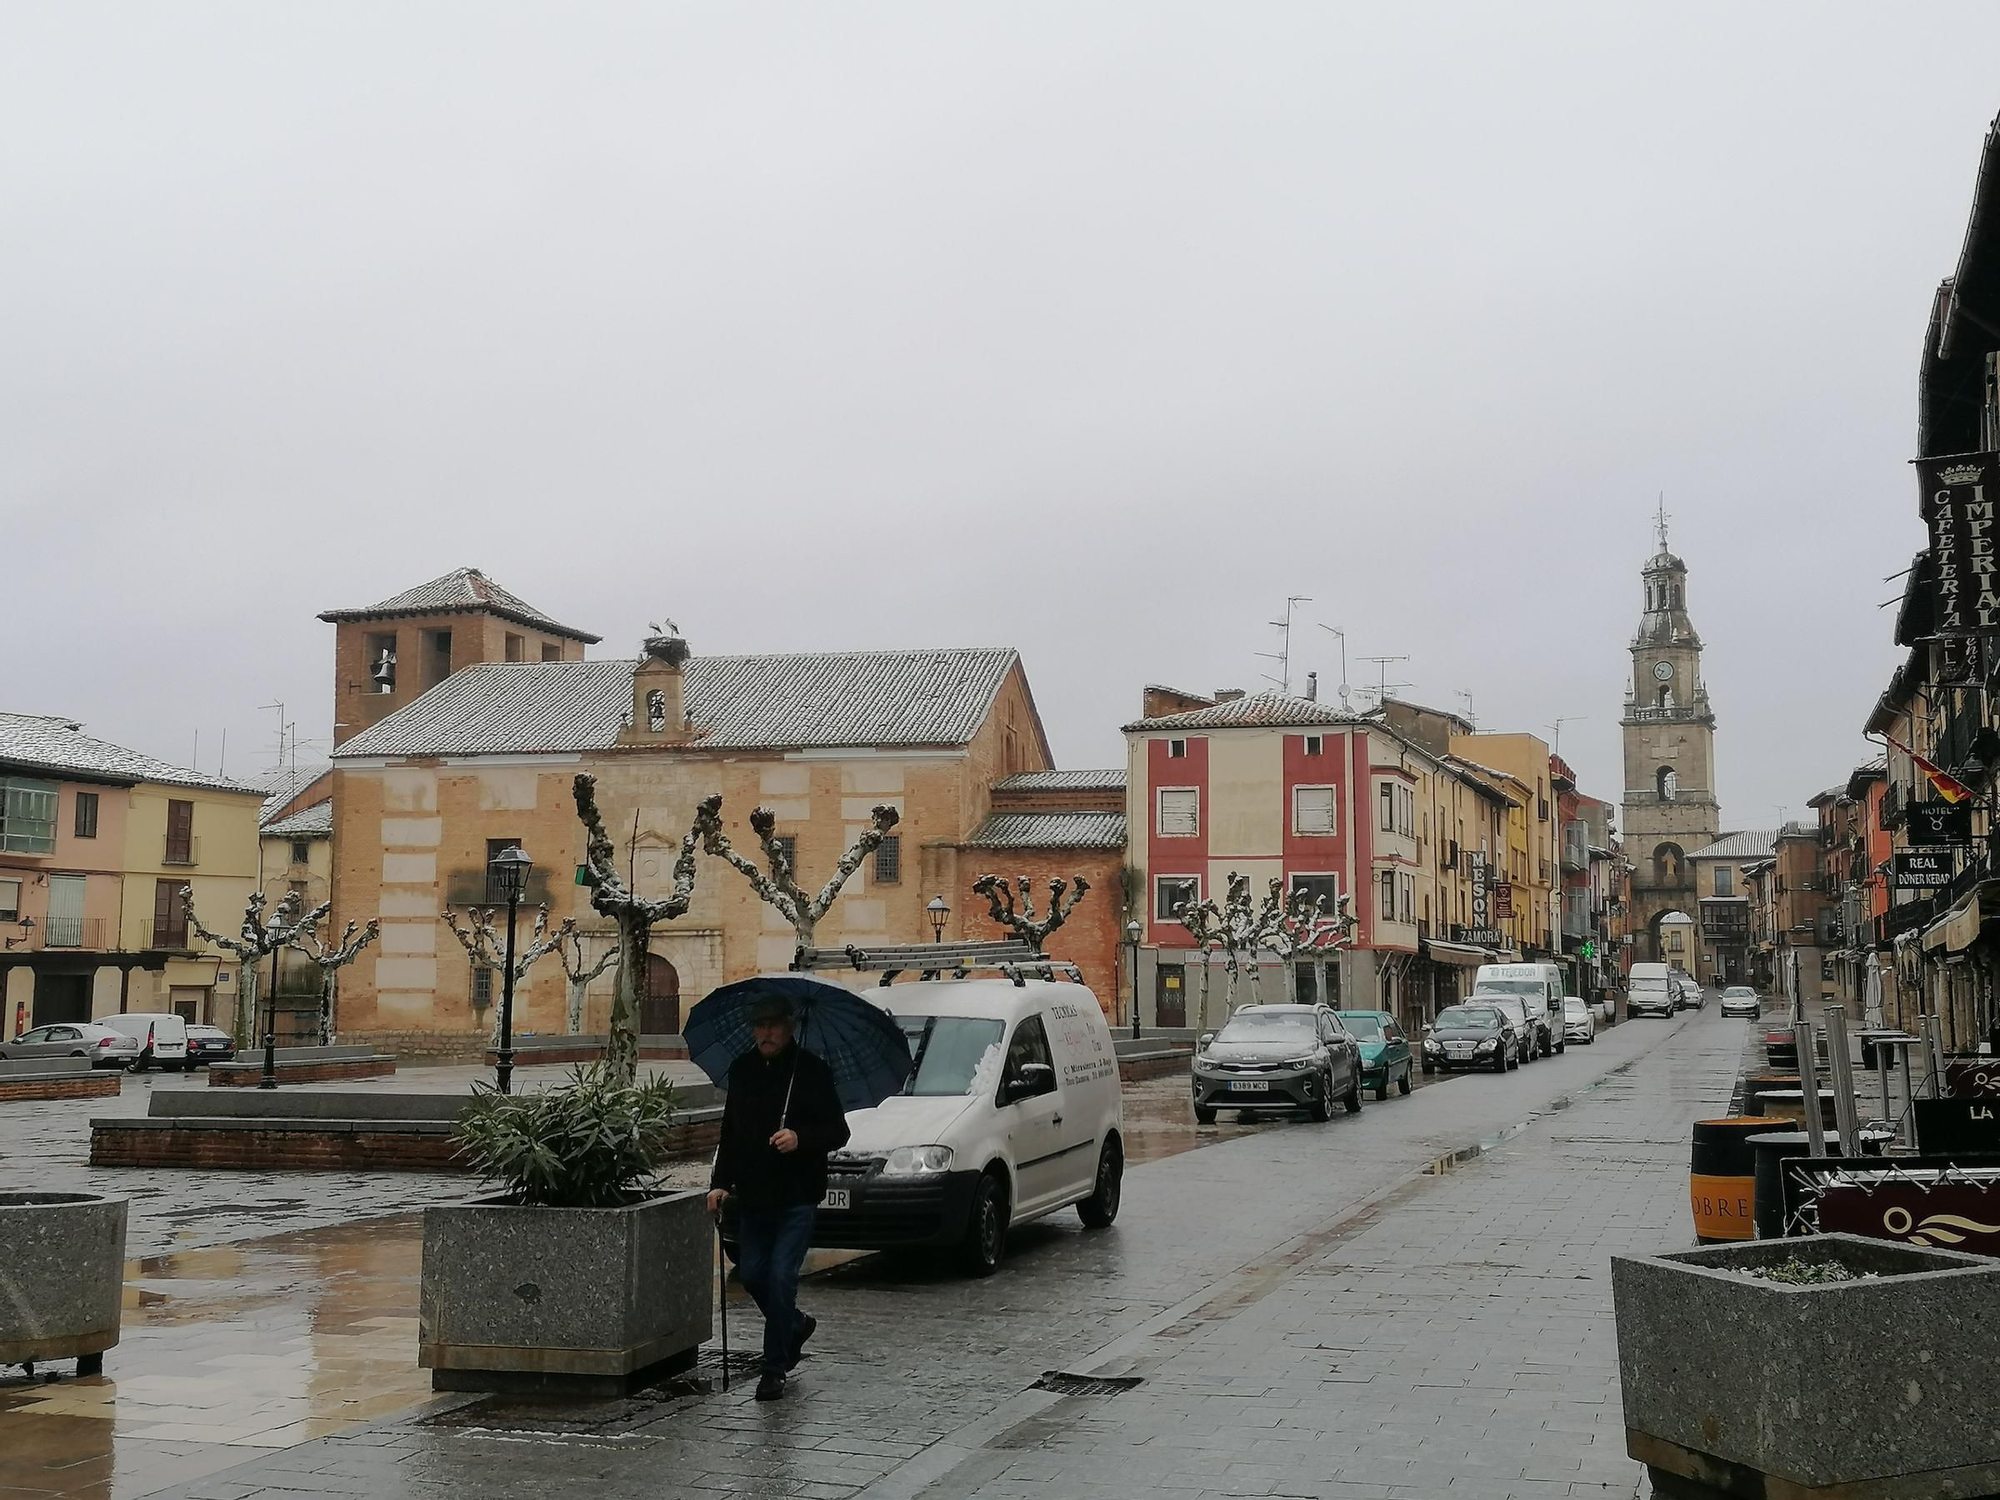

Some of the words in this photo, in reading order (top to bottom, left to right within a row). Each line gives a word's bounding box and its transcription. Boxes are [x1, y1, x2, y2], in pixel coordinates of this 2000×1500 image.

[1934, 489, 1961, 628] CAFETERÍA
[1964, 485, 1998, 626] IMPERIAL
[1909, 858, 1938, 869] REAL
[1472, 853, 1486, 928] MESON
[1460, 930, 1500, 943] ZAMORA
[1970, 1106, 1994, 1120] LA
[828, 1191, 846, 1206] DR
